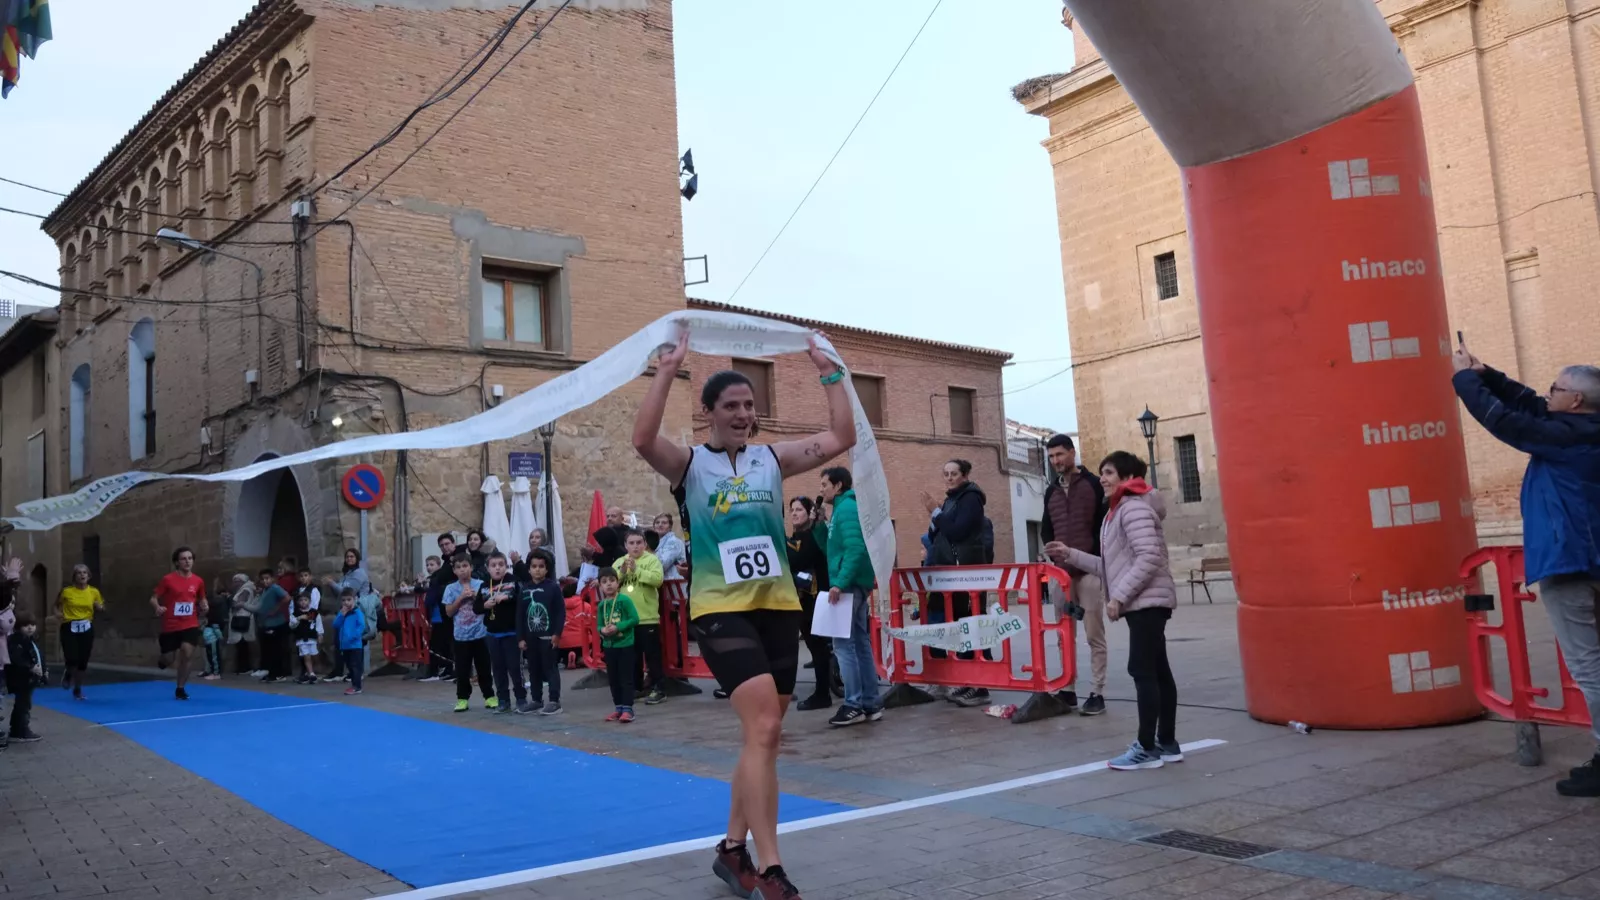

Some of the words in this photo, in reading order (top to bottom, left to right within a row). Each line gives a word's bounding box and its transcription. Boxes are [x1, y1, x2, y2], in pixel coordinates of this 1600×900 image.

[1341, 257, 1426, 281] hinaco
[1362, 420, 1446, 445] hinaco
[735, 550, 771, 579] 69
[178, 604, 191, 614] 40
[1382, 585, 1465, 611] hinaco
